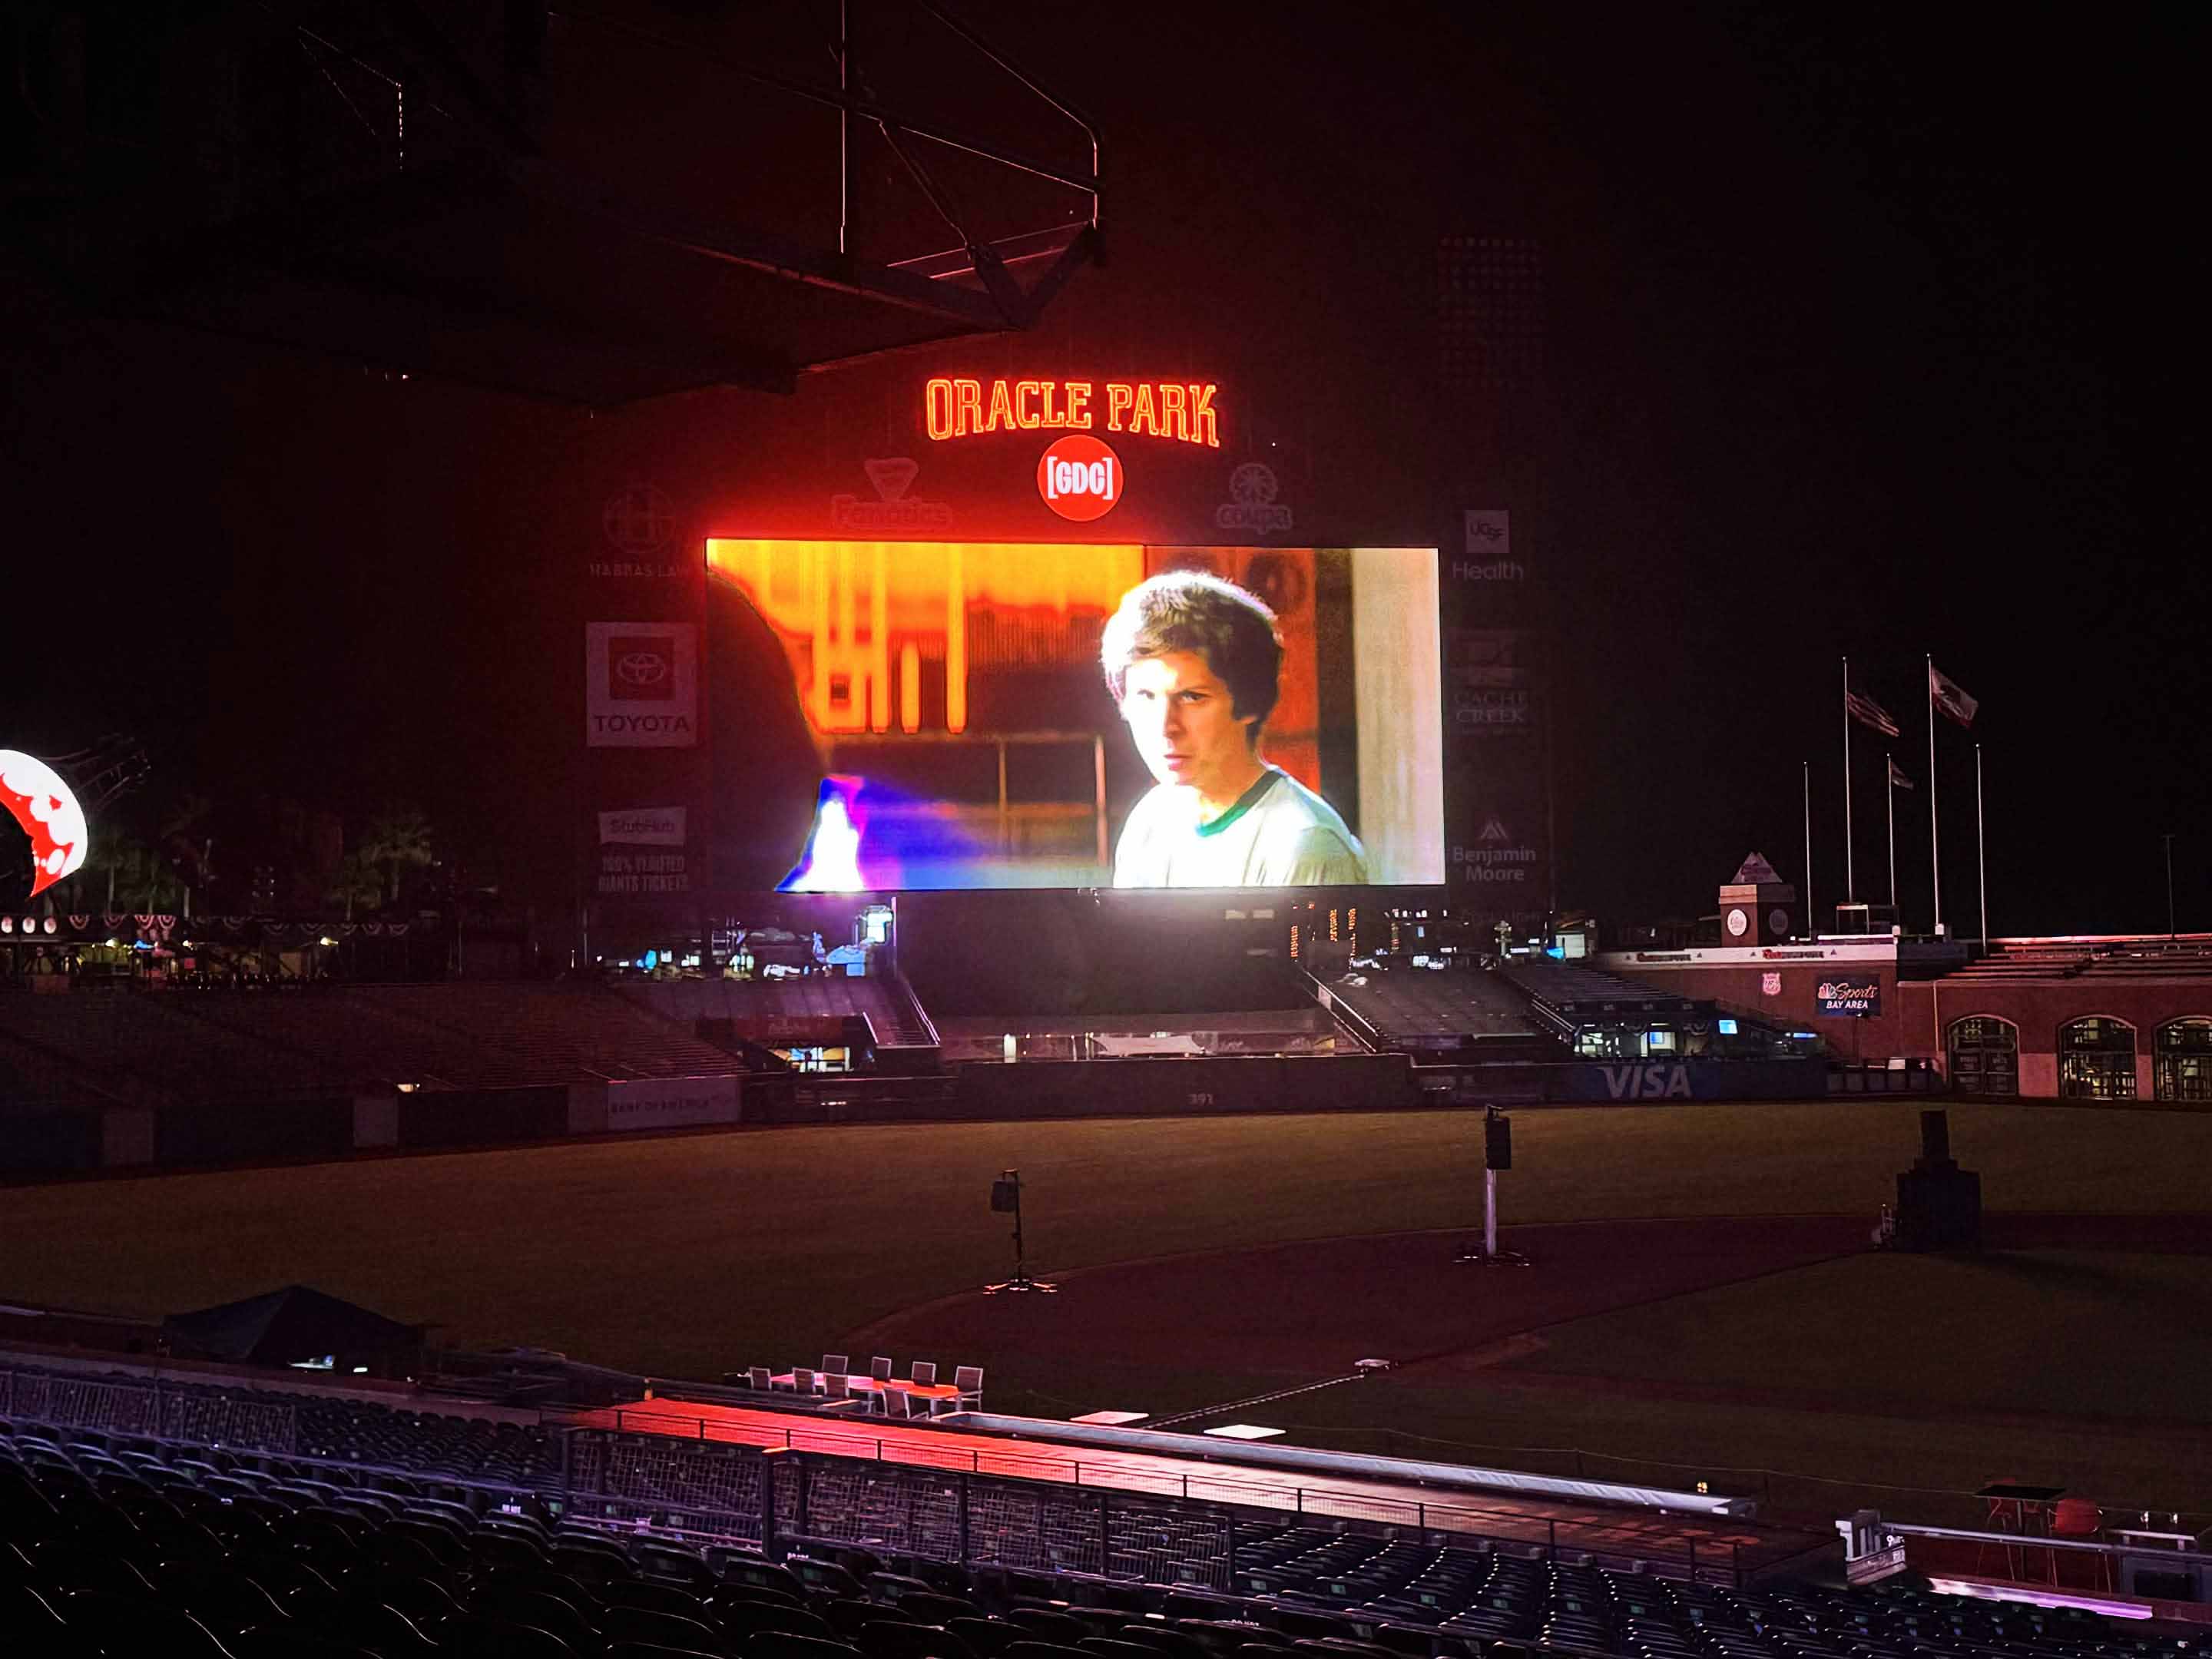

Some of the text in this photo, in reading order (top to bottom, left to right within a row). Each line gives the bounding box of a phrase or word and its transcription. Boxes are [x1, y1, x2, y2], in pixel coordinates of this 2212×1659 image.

[926, 379, 1220, 448] ORACLE PARK
[1452, 561, 1524, 580] Health
[593, 714, 690, 732] TOYOTA
[1452, 846, 1536, 866] Benjamin
[1465, 866, 1524, 882] Moore
[1836, 983, 1879, 1002] Sports
[1826, 999, 1869, 1009] BAY AREA
[1598, 1065, 1693, 1099] VISA
